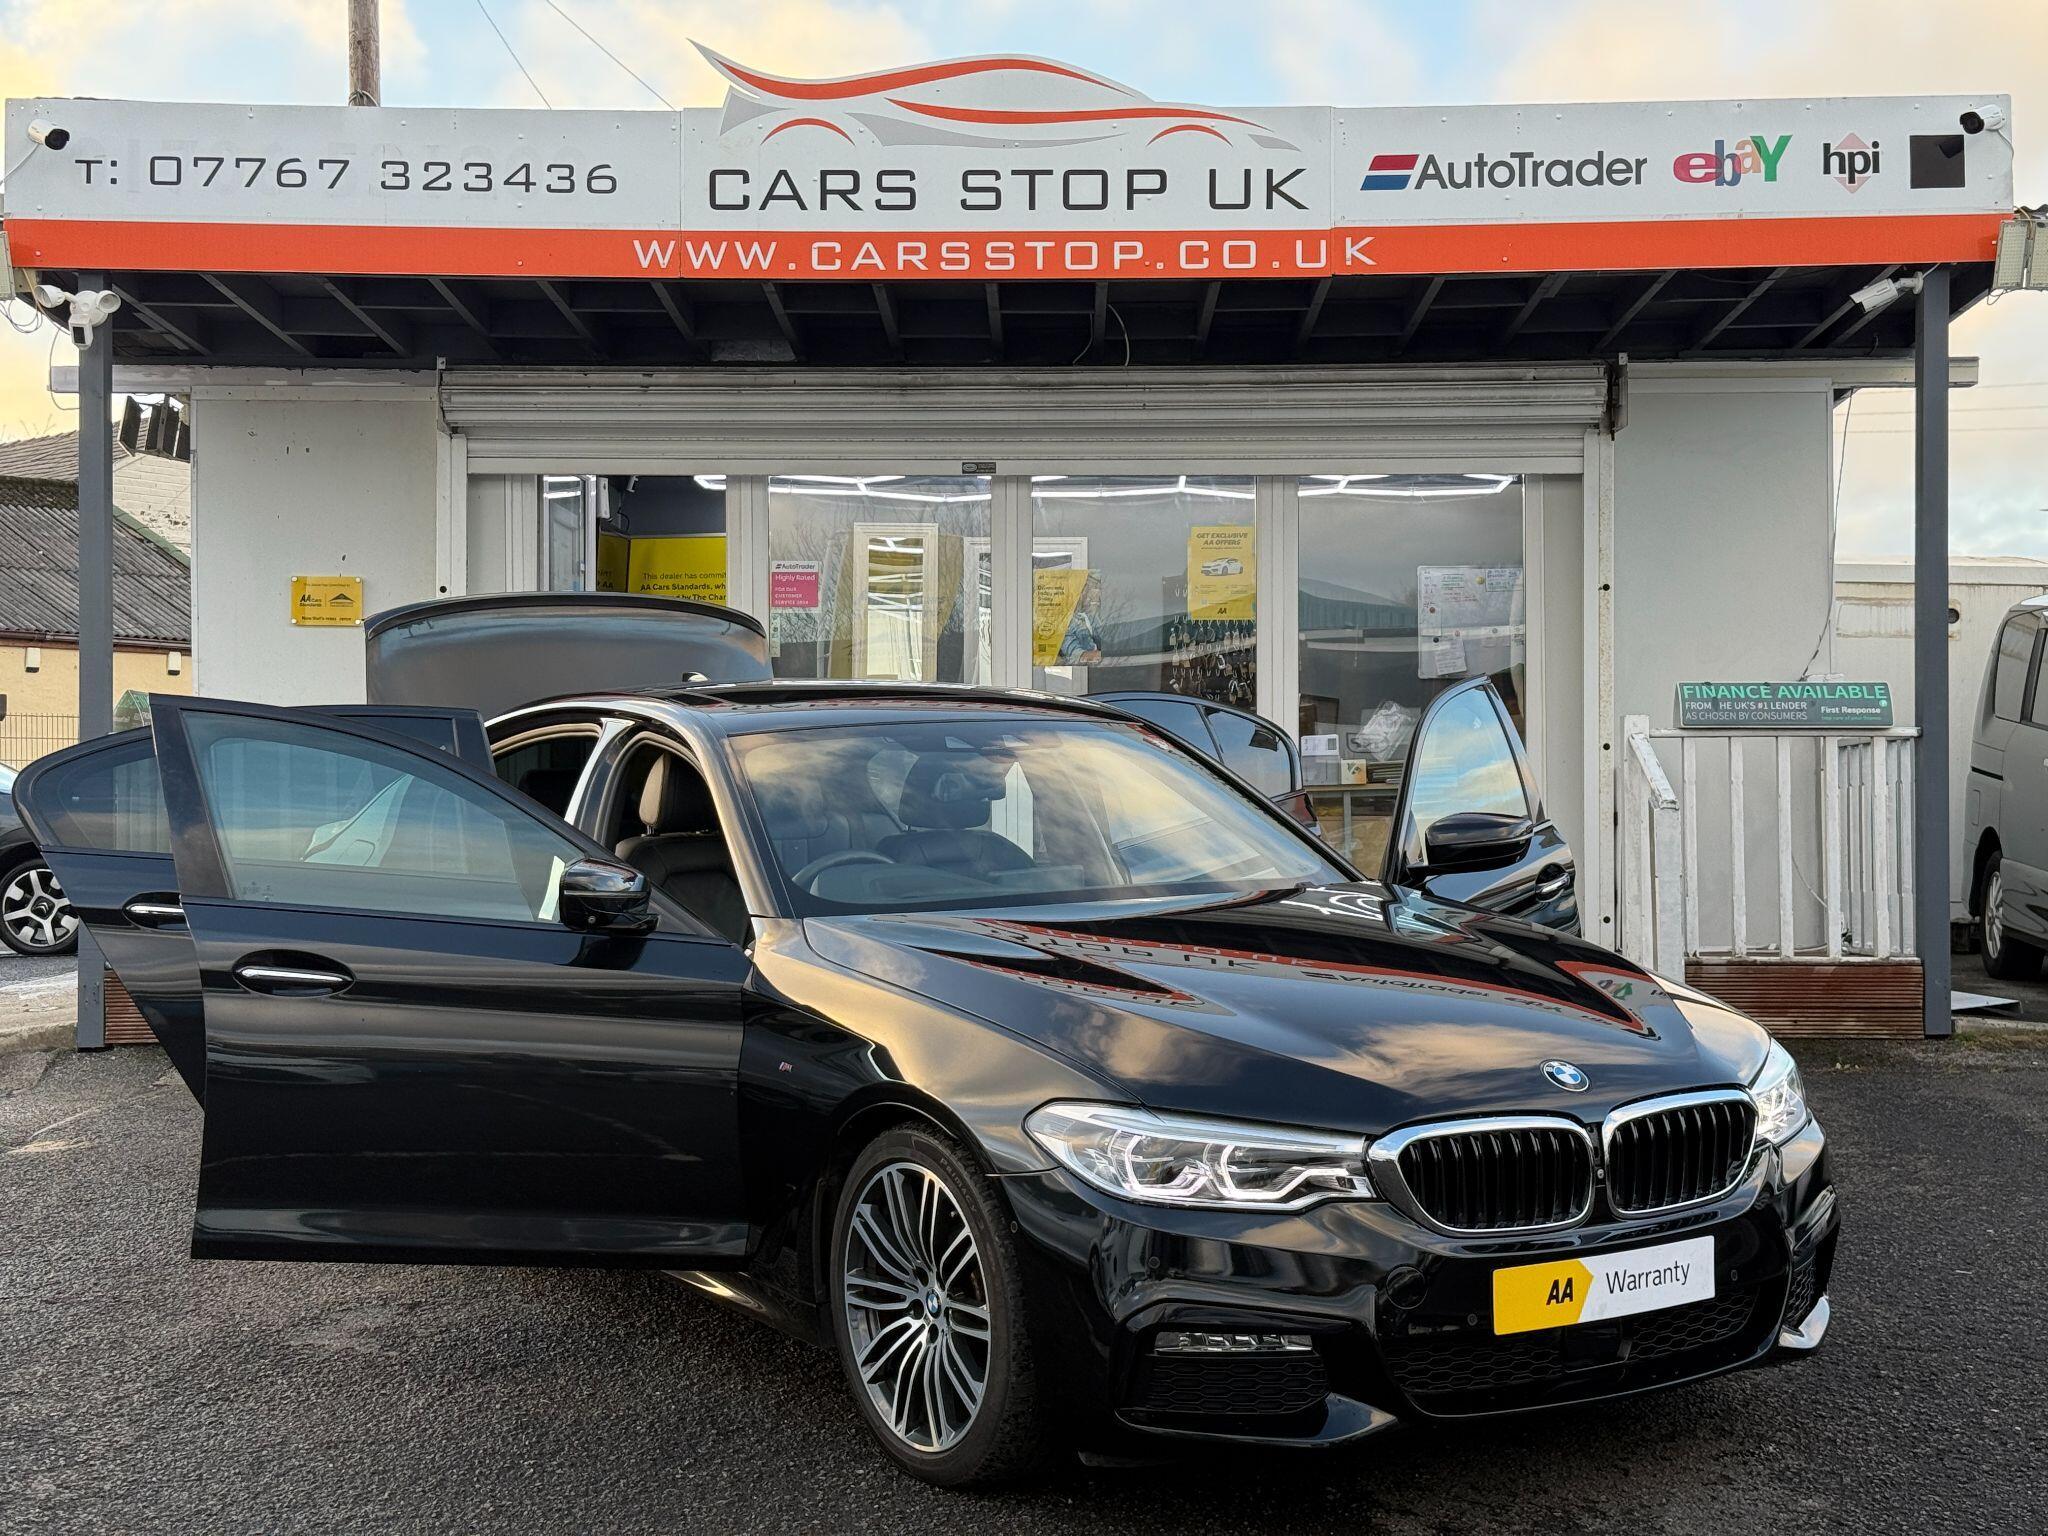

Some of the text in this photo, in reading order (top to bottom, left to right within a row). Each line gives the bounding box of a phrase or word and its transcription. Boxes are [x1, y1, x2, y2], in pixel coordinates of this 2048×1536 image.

[1822, 140, 1880, 185] hpi
[74, 155, 617, 195] T: 07767 323436
[1414, 150, 1648, 190] AutoTrader
[709, 168, 1310, 212] CARS STOP UK
[633, 236, 1377, 272] WWW.CARSSTOP.CO.UK
[643, 572, 657, 580] This
[685, 571, 698, 579] has
[775, 574, 796, 582] Highly
[672, 583, 713, 591] Standards,
[1217, 607, 1227, 615] AA
[1682, 685, 1888, 699] FINANCE AVAILABLE
[1685, 701, 1712, 710] FROM
[1734, 701, 1756, 710] UK'S
[1770, 701, 1808, 710] LENDER
[1820, 706, 1881, 715] First Response
[1685, 711, 1808, 720] AS CHOSEN BY CONSUMERS
[1545, 1260, 1691, 1306] AA Warranty
